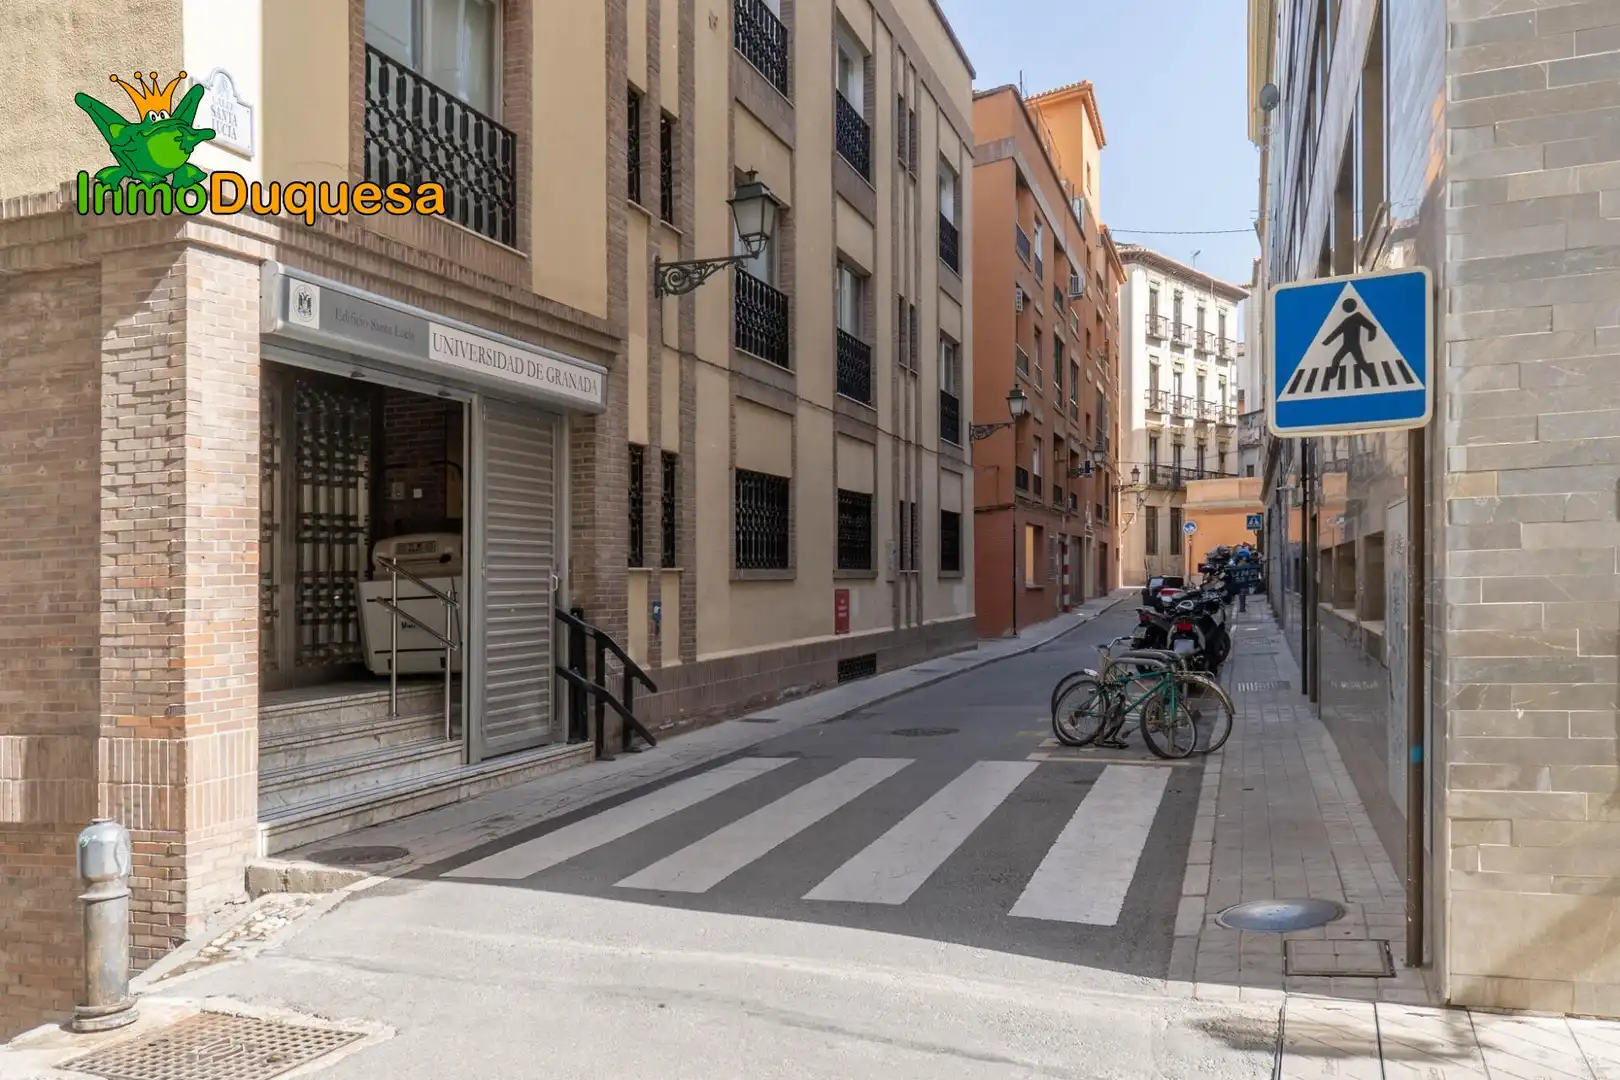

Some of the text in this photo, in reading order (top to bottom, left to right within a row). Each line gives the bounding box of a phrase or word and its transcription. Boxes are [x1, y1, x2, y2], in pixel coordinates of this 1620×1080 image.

[210, 104, 238, 127] SANTA
[370, 318, 393, 335] Santa
[432, 331, 599, 396] UNIVERSIDAD DE GRANADA
